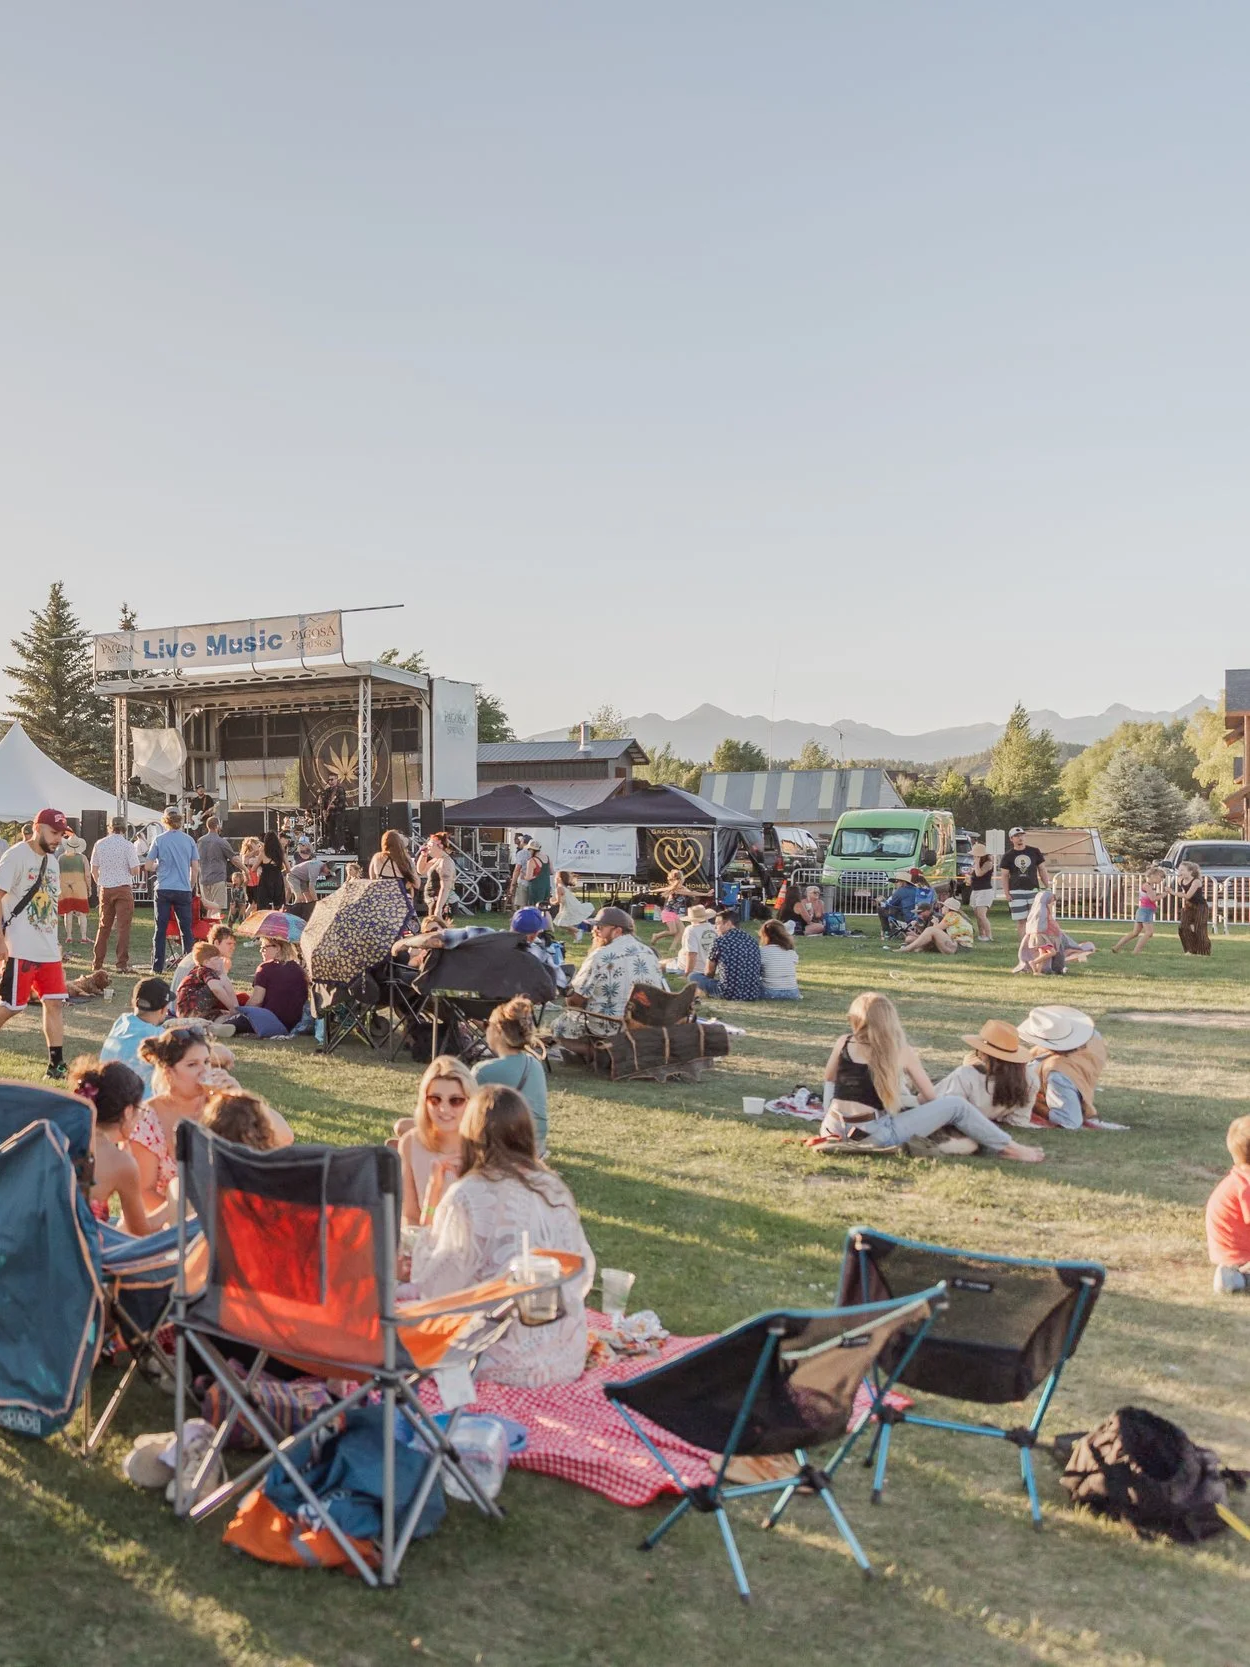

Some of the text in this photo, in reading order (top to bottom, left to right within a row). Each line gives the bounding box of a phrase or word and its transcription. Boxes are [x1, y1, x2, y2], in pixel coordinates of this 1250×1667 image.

[290, 626, 336, 641] PAGOSA
[101, 643, 136, 655] PAGOSA
[143, 629, 283, 659] Live Music
[296, 640, 332, 651] SPRINGS
